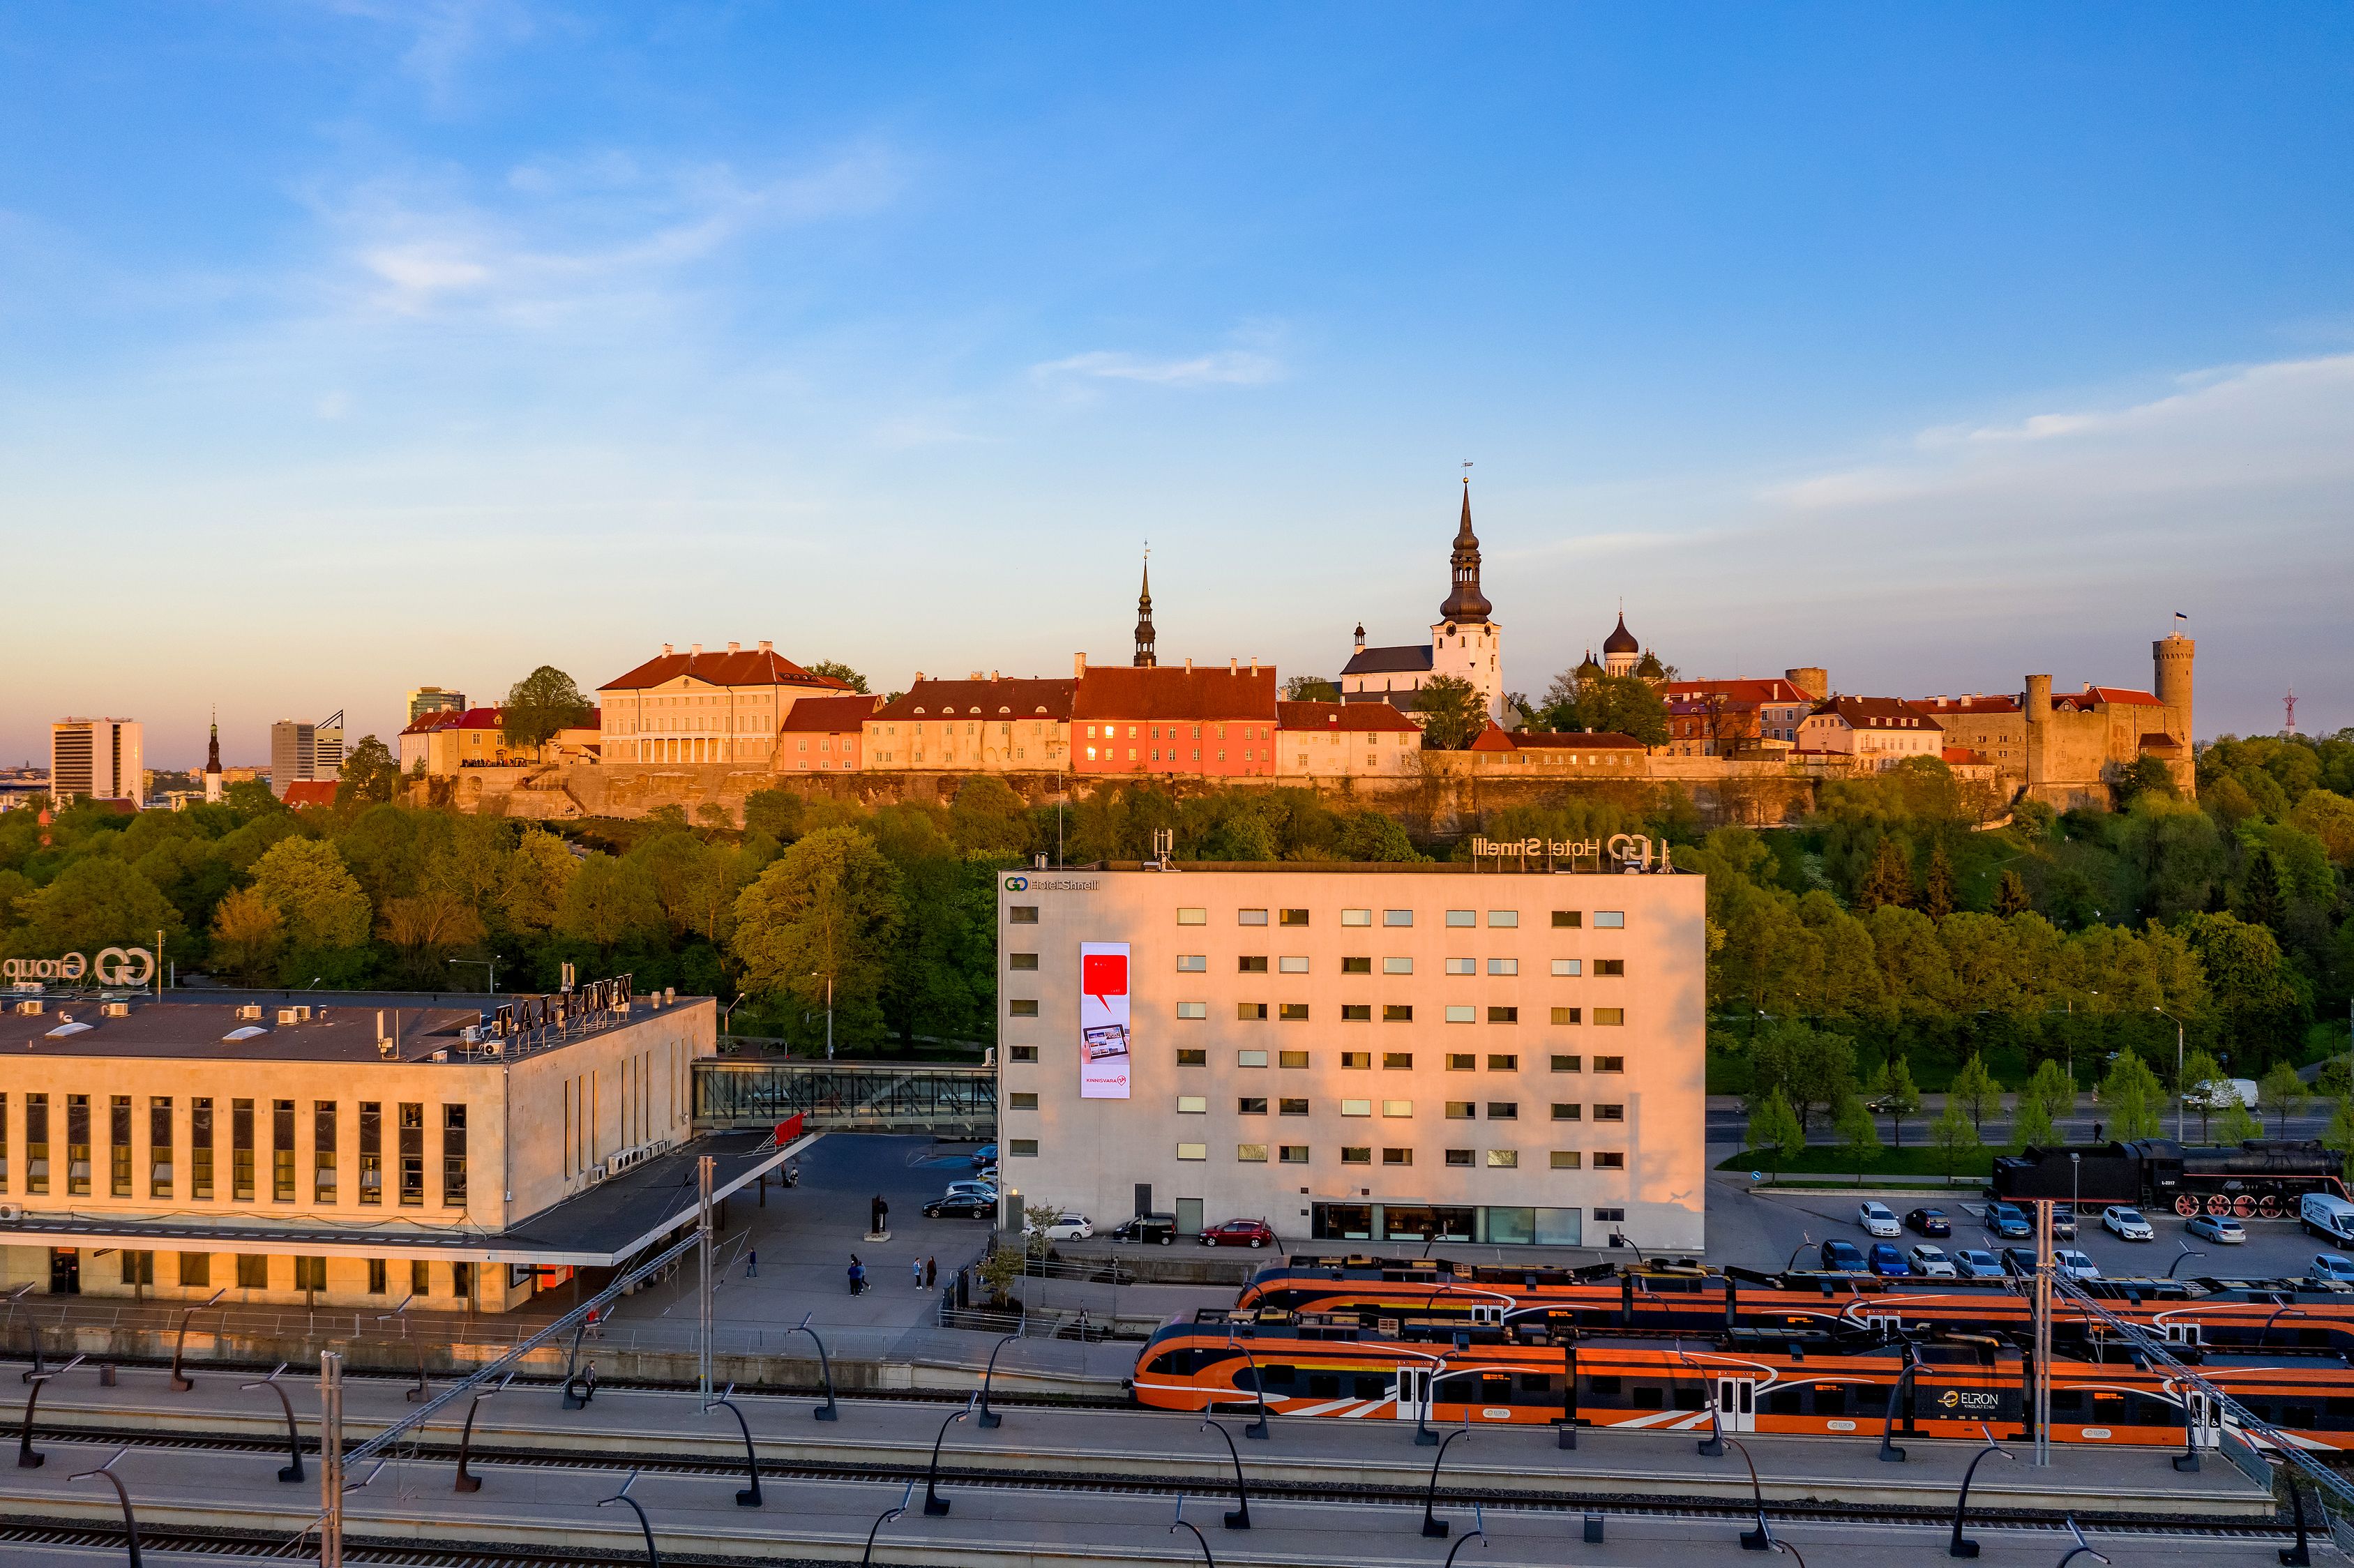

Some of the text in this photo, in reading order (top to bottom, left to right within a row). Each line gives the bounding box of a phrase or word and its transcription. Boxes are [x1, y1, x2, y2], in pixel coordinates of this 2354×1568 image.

[1004, 877, 1100, 891] GO Hotel Shnelli
[495, 973, 633, 1039] TALLINN
[1961, 1393, 1998, 1405] ELRON
